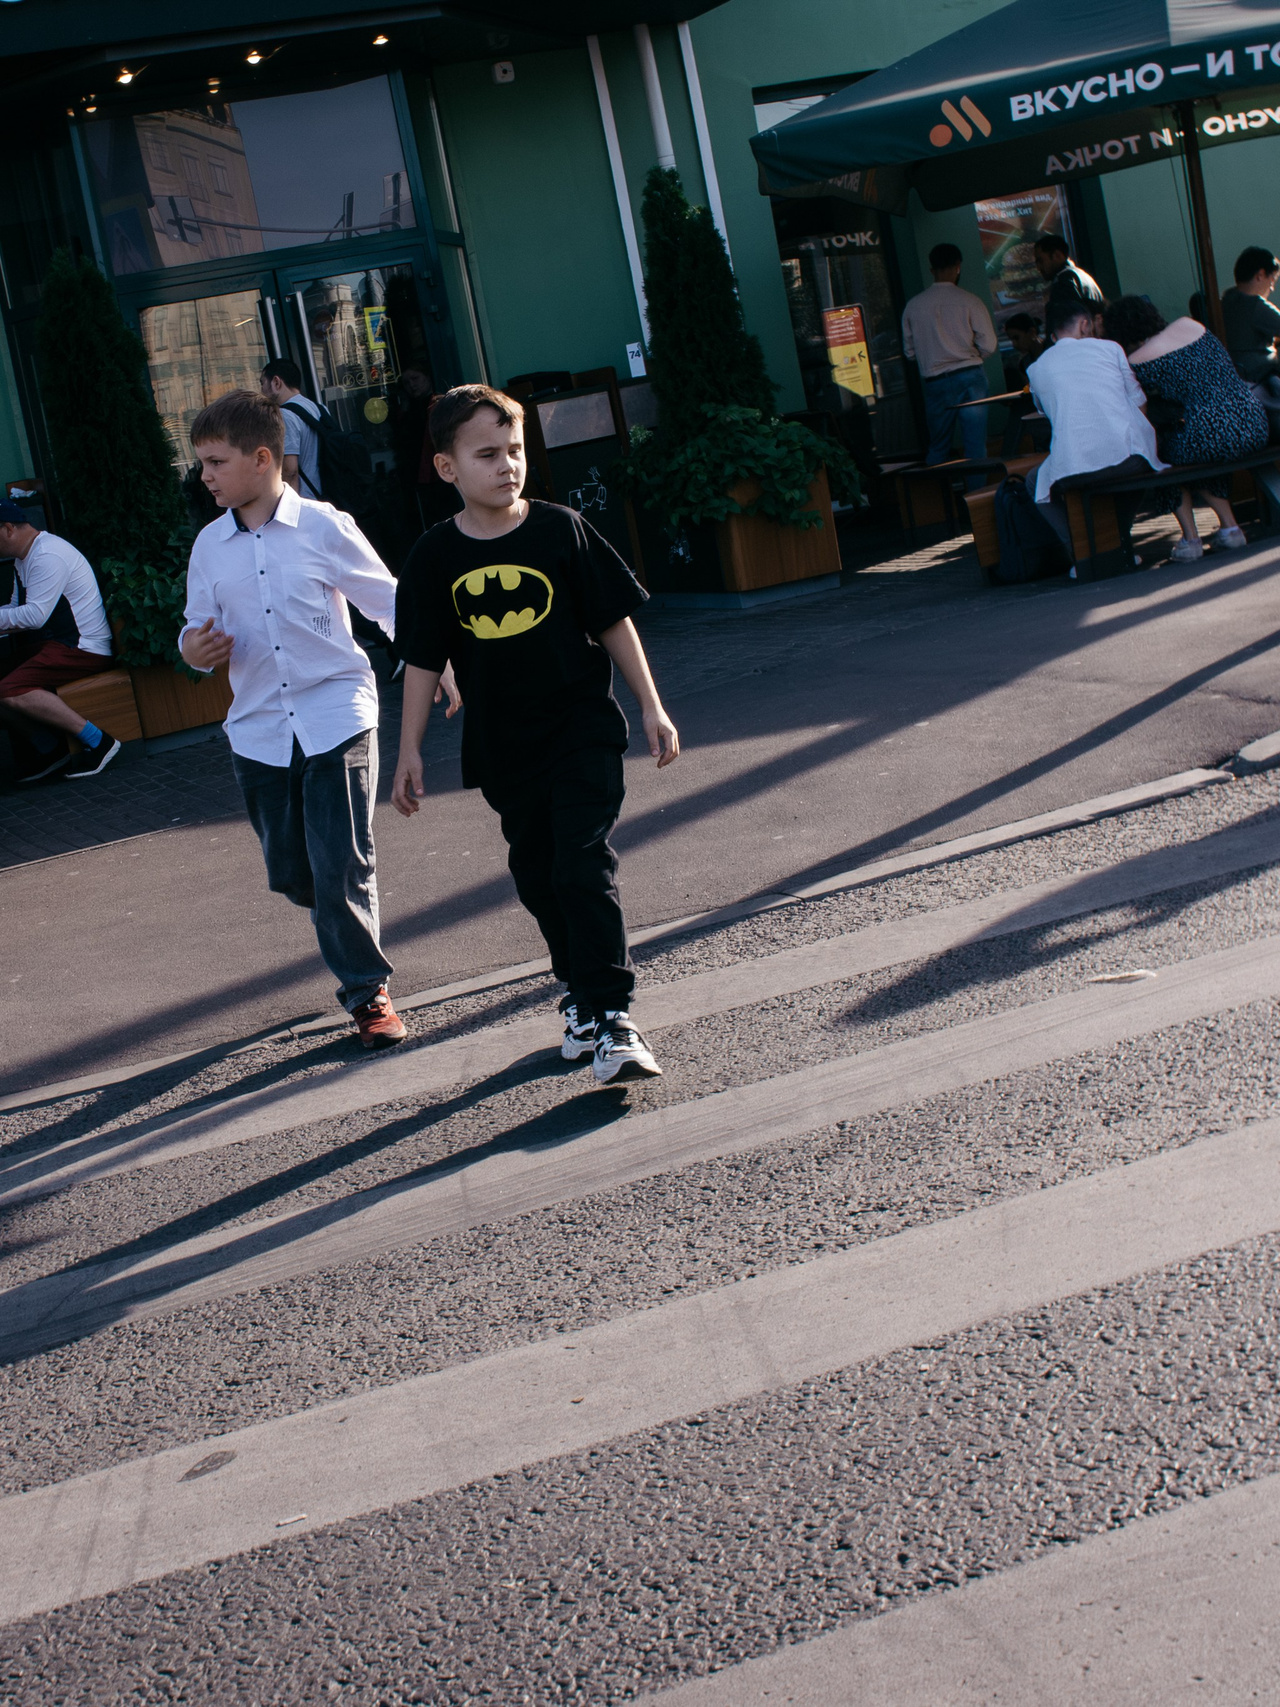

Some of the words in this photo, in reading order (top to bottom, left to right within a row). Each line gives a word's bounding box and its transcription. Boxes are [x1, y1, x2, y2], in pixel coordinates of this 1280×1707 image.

[1010, 62, 1165, 121] ВКУСНО
[1206, 49, 1235, 79] И
[628, 350, 641, 359] 74
